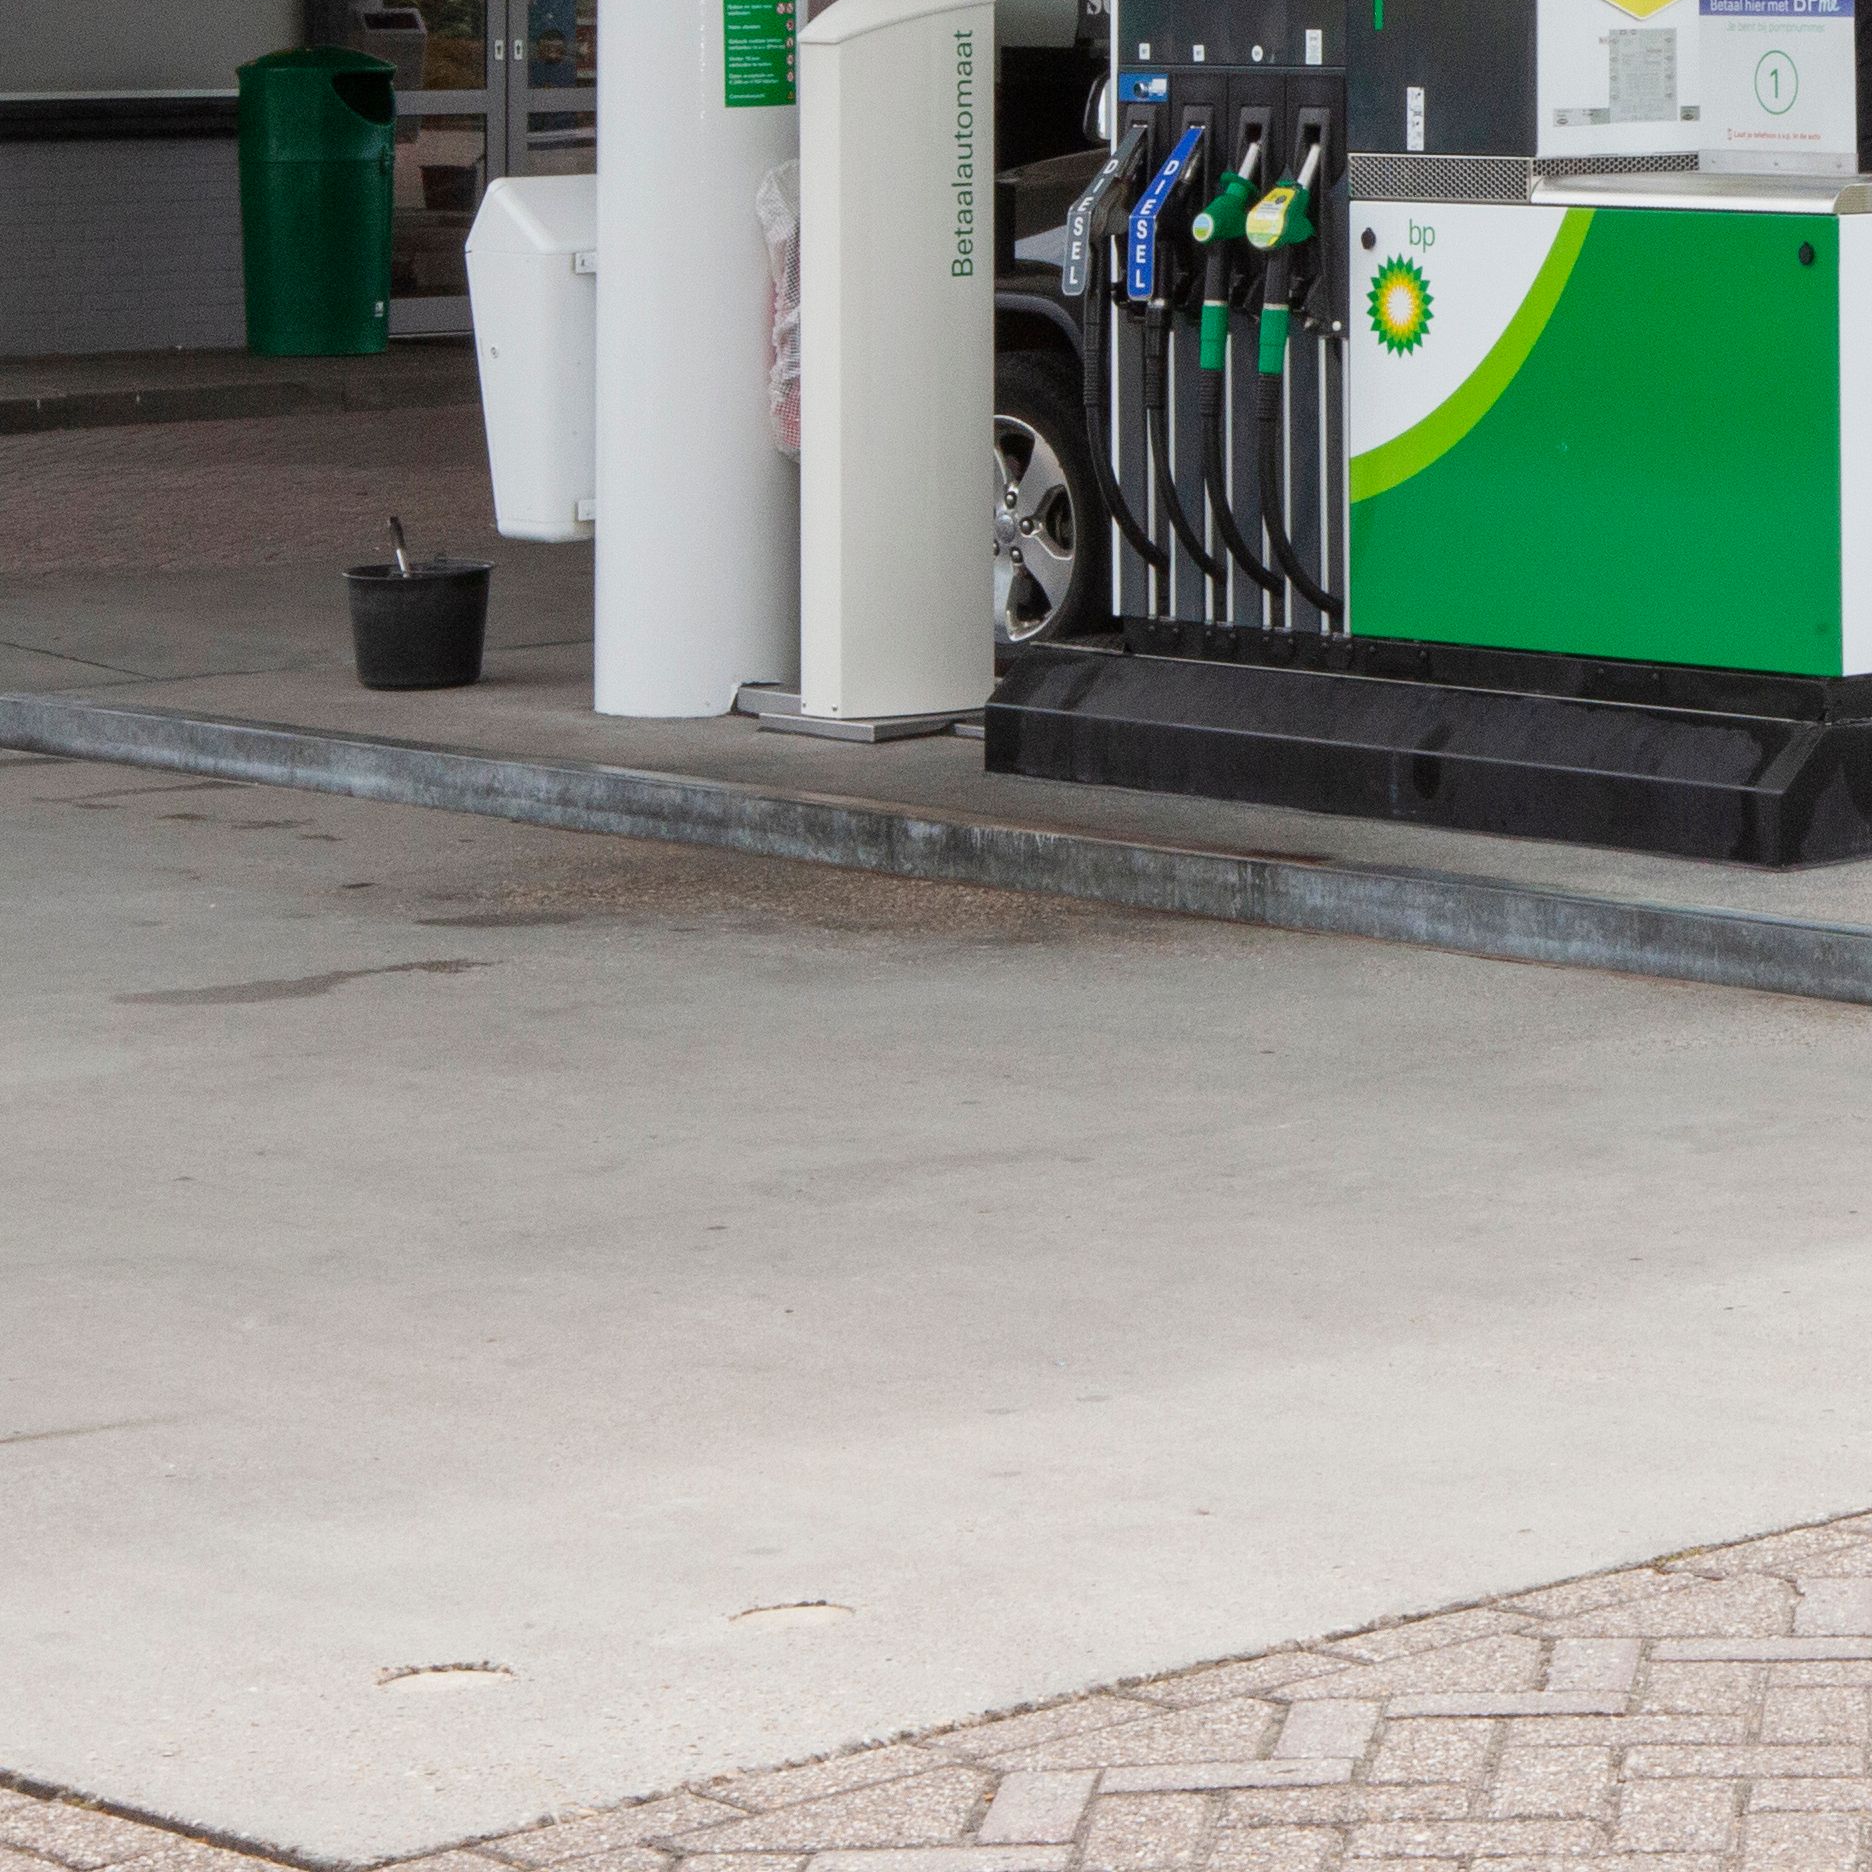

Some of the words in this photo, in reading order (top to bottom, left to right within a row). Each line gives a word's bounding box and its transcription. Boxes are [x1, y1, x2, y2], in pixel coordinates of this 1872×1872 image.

[1768, 0, 1789, 12] met
[1769, 67, 1779, 99] 1
[951, 29, 975, 278] Betaalautomaat
[1069, 159, 1119, 286] DIESEL
[1135, 159, 1180, 289] DIESEL
[1408, 219, 1436, 253] bp
